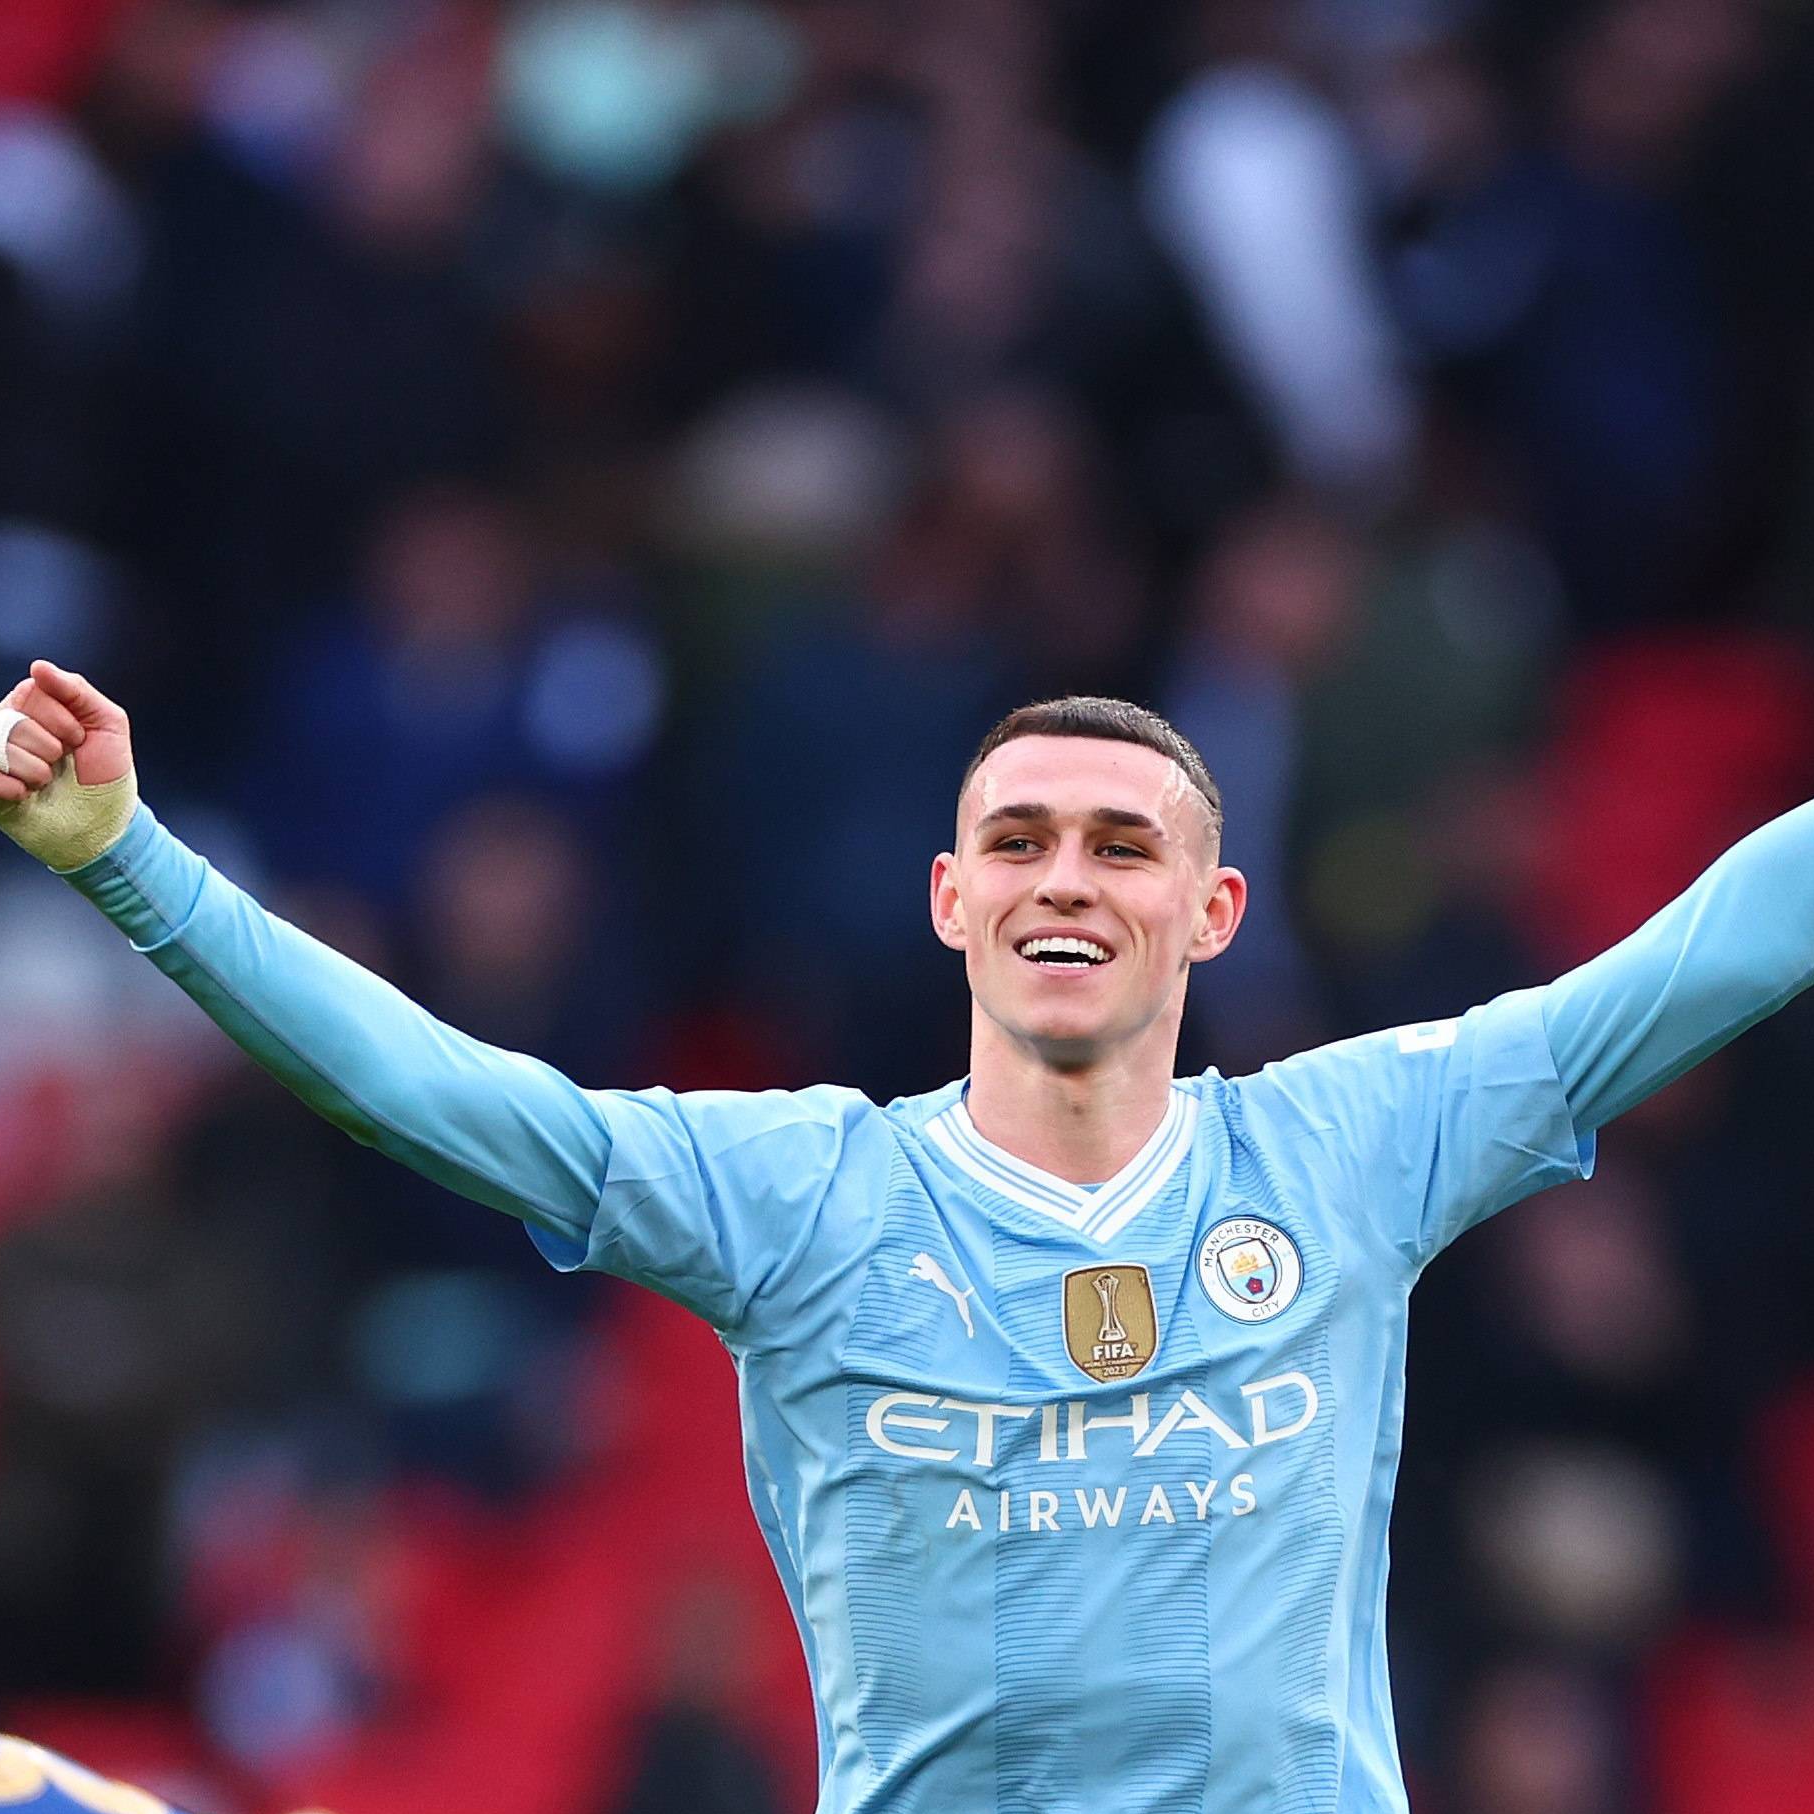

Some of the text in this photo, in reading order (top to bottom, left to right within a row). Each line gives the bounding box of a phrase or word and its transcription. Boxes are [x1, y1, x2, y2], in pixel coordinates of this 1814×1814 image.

[1204, 1224, 1280, 1268] MANCHESTER
[1251, 1299, 1280, 1318] CITY
[1093, 1343, 1134, 1360] FIFA
[1102, 1365, 1127, 1377] 2023
[865, 1371, 1319, 1467] ETIHAD
[945, 1473, 1258, 1531] AIRWAYS
